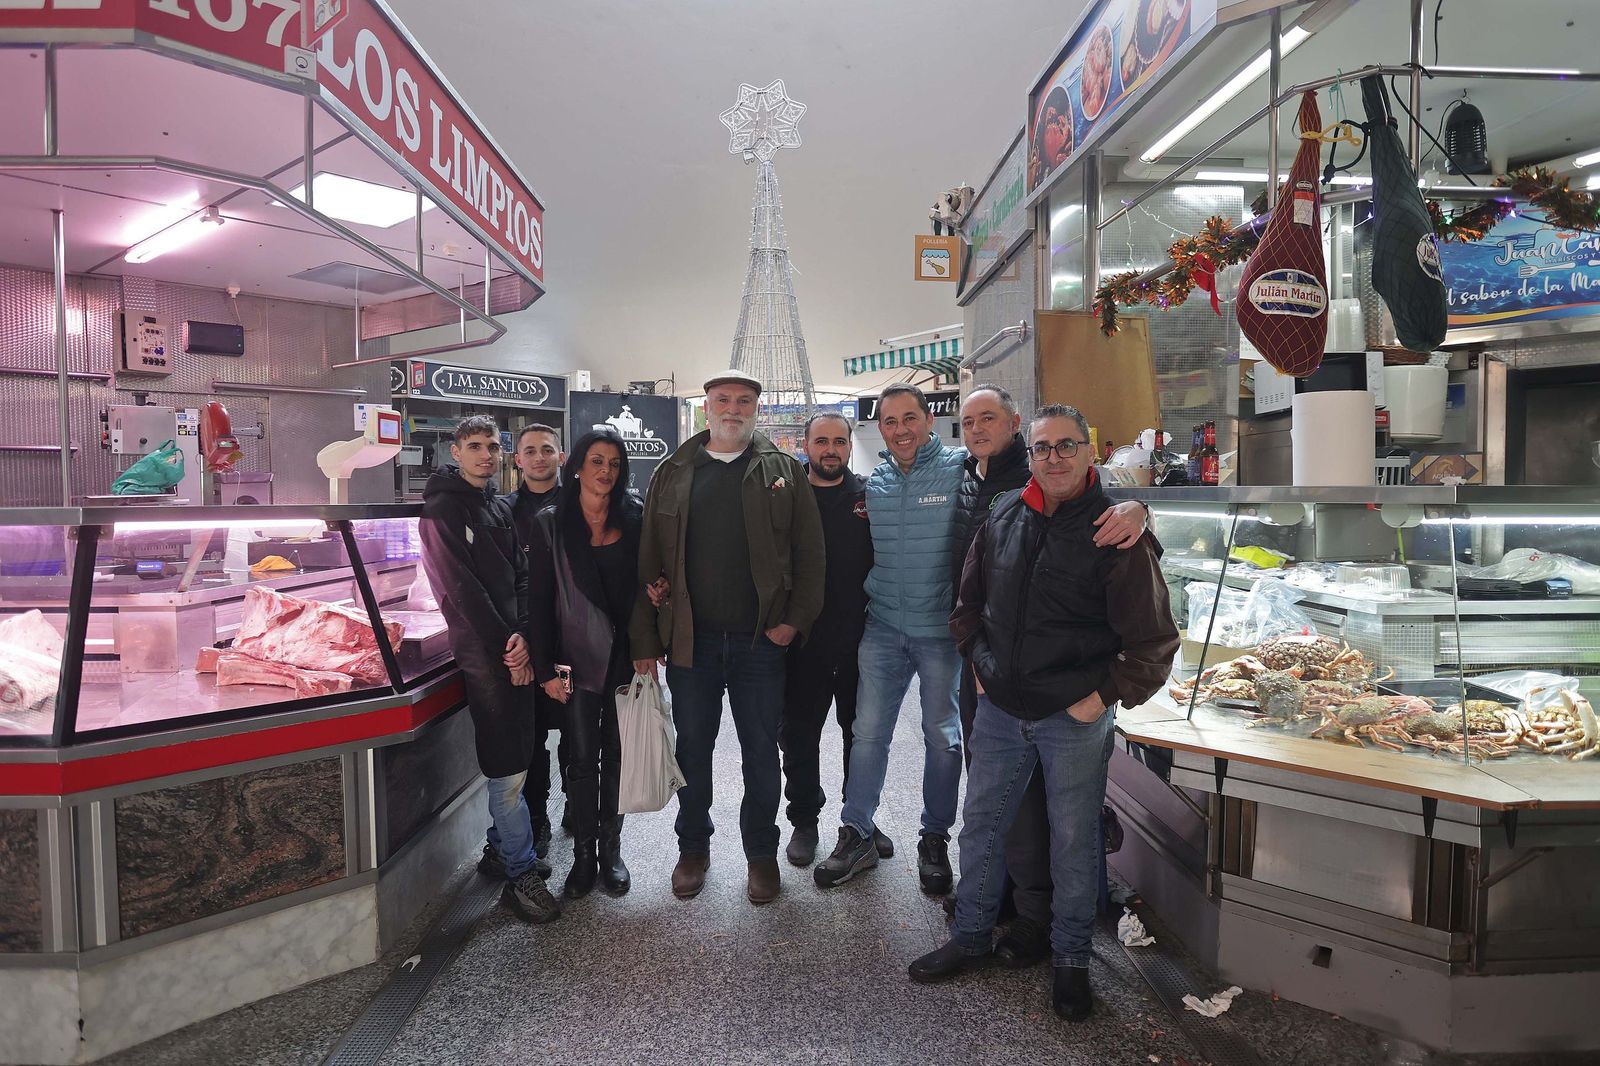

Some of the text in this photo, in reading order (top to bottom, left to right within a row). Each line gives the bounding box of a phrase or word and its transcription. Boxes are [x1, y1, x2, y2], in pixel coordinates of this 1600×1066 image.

[149, 0, 302, 48] 07
[317, 28, 542, 270] LOS LIMPIOS
[1545, 253, 1589, 265] MARISCOS
[1255, 286, 1289, 299] Julián
[1460, 284, 1513, 305] sabor
[1518, 279, 1539, 298] de
[1544, 275, 1564, 295] la
[447, 372, 538, 396] J.M. SANTOS
[927, 396, 960, 414] artí
[624, 442, 660, 453] ANTOS
